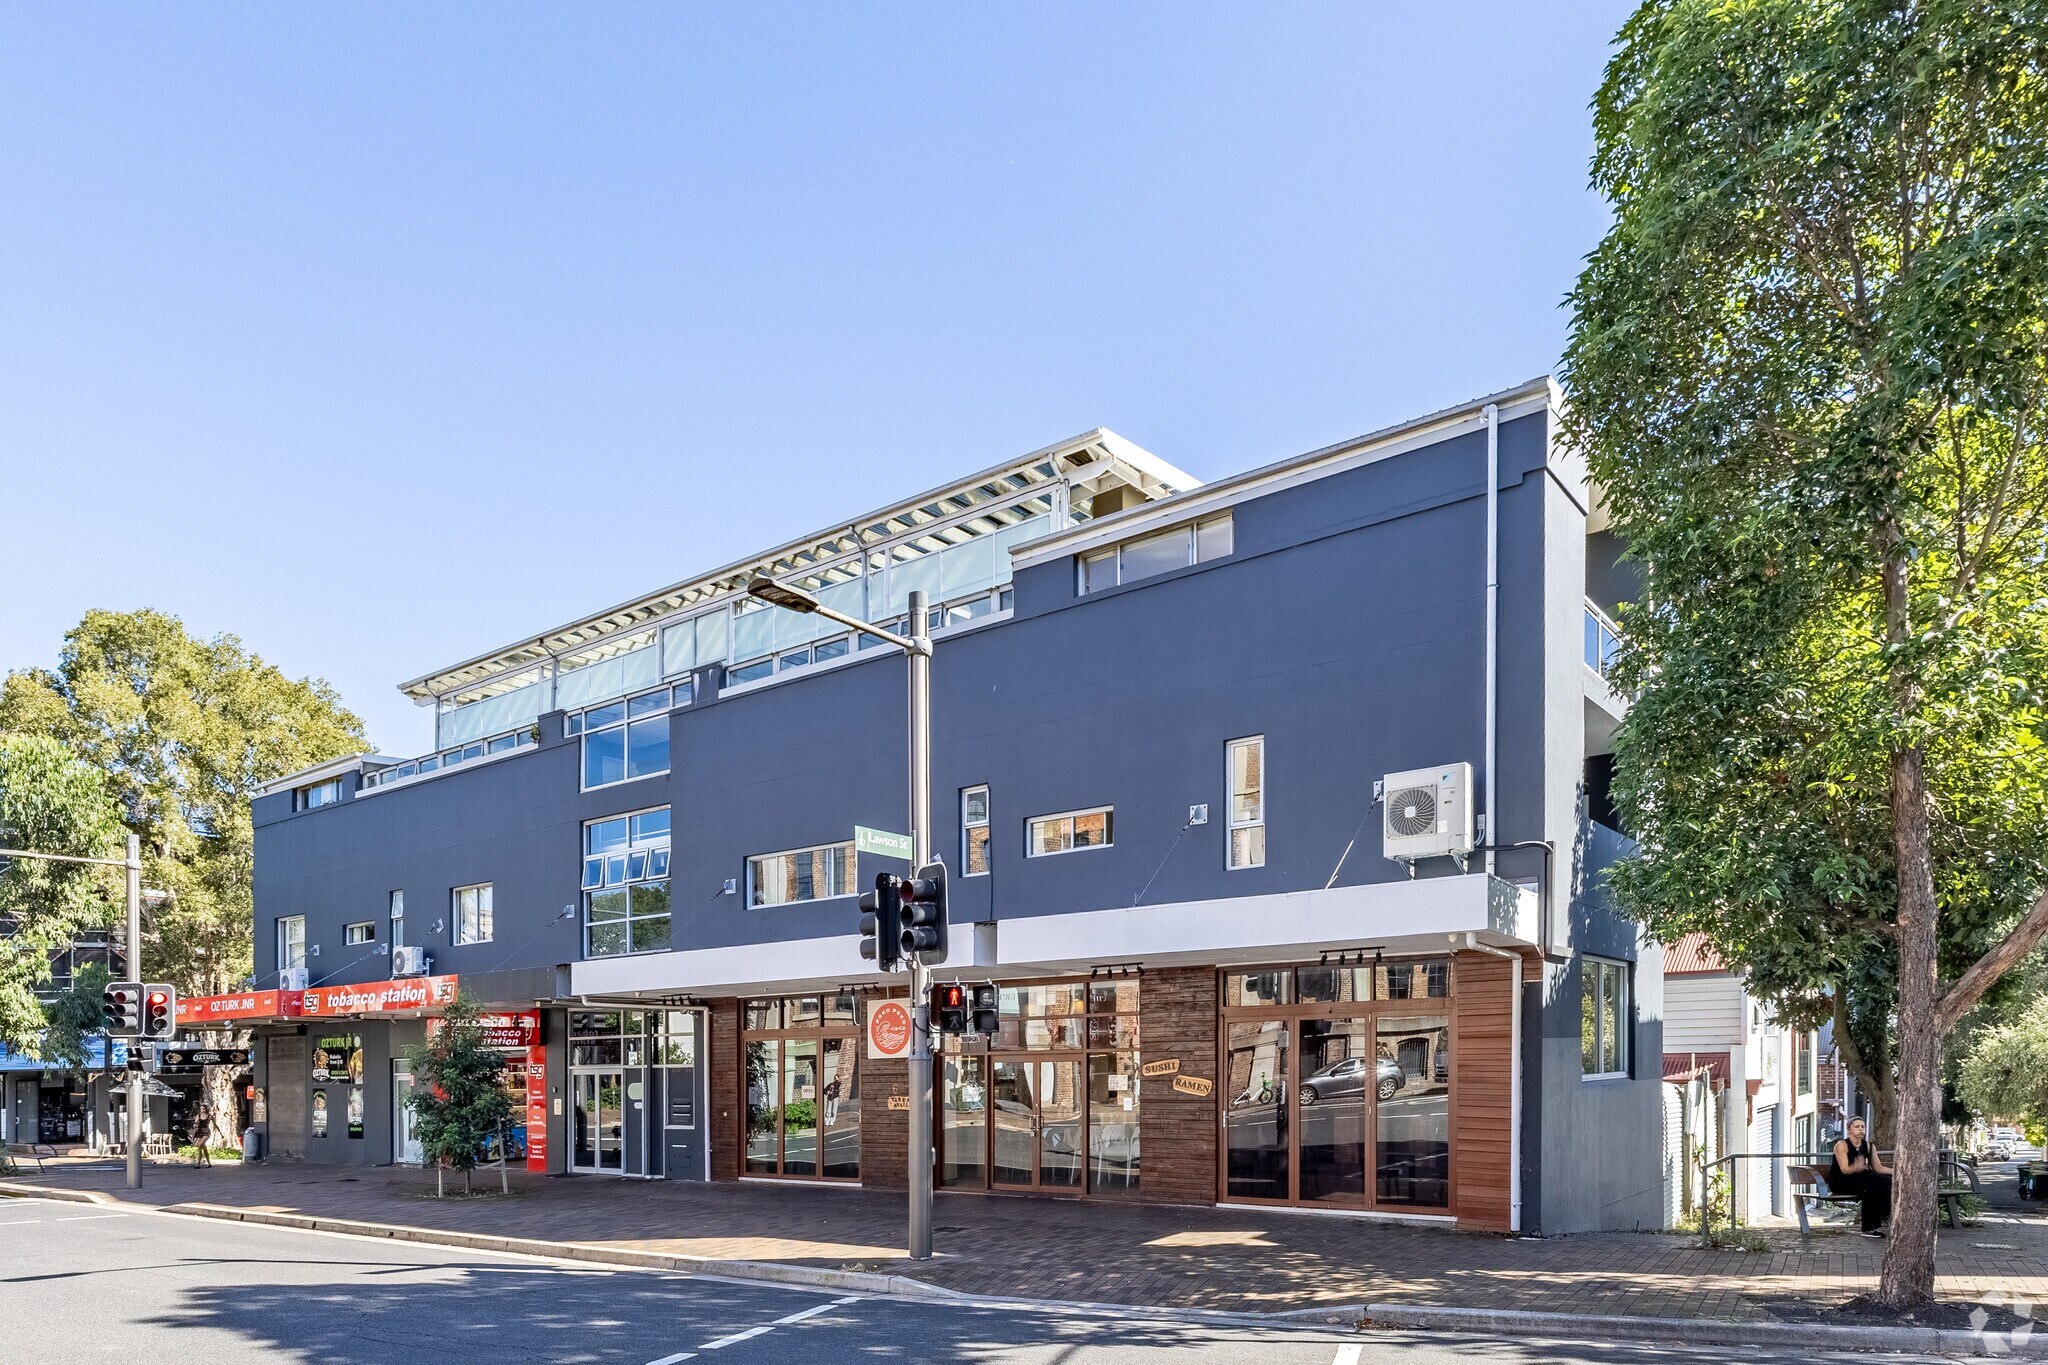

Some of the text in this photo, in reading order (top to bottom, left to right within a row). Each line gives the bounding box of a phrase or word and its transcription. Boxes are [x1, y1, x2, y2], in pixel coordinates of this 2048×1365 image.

[869, 831, 908, 850] Lawson St
[210, 1001, 221, 1012] OZ
[221, 999, 240, 1011] TURK
[240, 998, 255, 1010] JNR
[303, 991, 320, 1014] tsg
[327, 991, 376, 1008] tobacco
[379, 986, 427, 1003] station
[875, 1008, 907, 1025] PEKO PEKO
[483, 1028, 522, 1037] obacco
[321, 1037, 345, 1048] OZTURK
[192, 1054, 221, 1062] OZTURK
[528, 1060, 545, 1080] tsg
[1145, 1062, 1176, 1074] SUSHI
[1175, 1077, 1211, 1093] RAMEN
